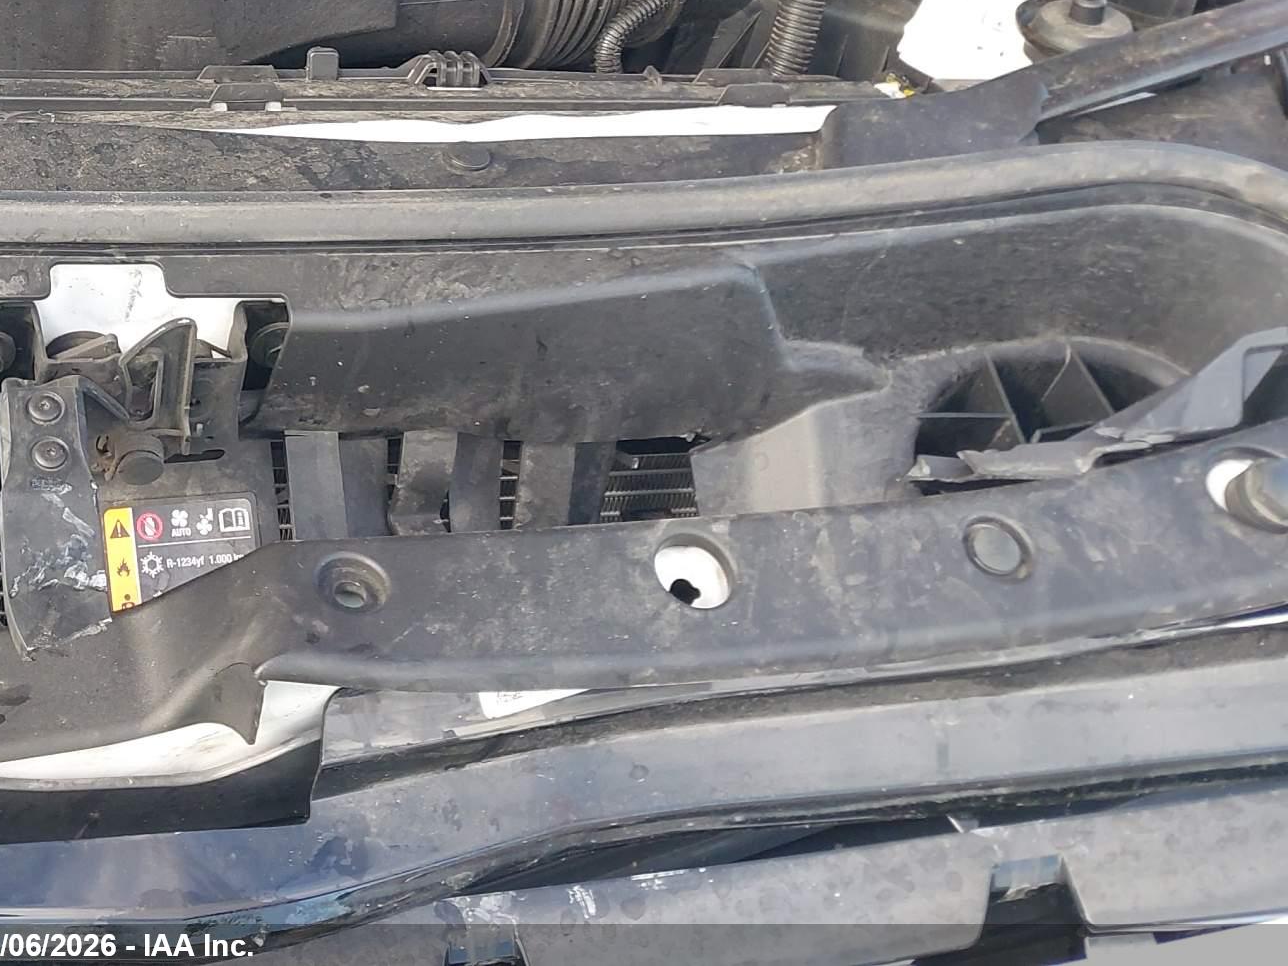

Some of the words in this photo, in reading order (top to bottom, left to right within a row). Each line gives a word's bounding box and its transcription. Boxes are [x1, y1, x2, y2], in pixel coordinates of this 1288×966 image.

[171, 527, 192, 537] AUTO
[166, 555, 205, 568] R-1234yf
[209, 553, 233, 564] 1.000
